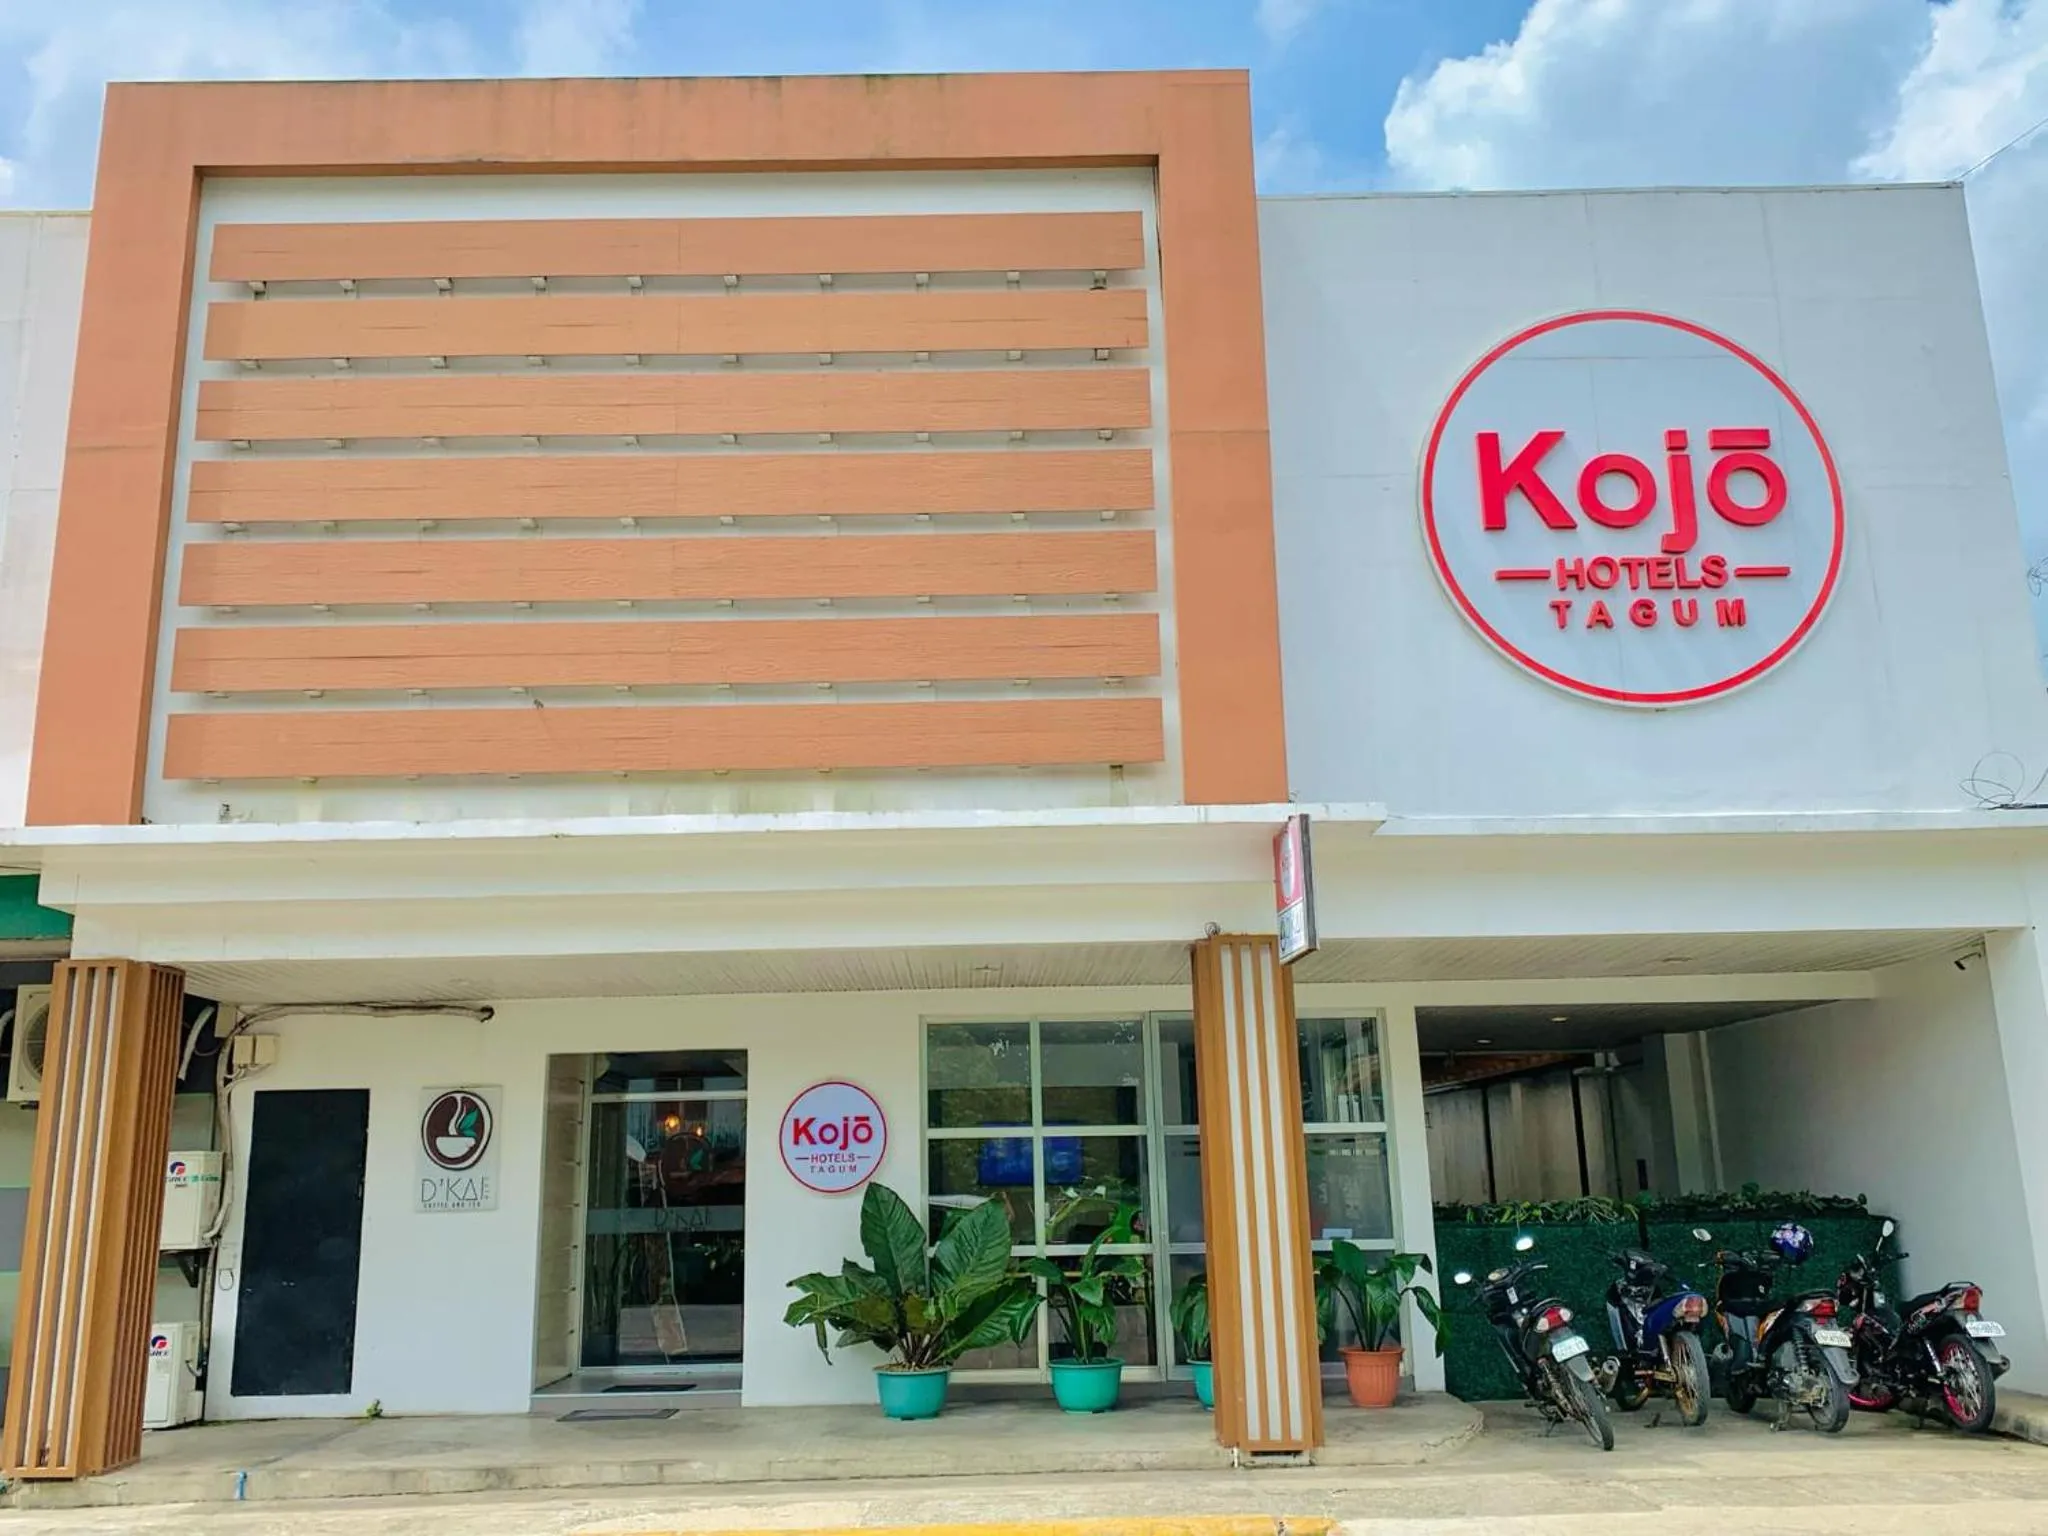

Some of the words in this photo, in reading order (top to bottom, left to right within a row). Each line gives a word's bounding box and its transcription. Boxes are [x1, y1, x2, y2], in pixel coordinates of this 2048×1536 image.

[1555, 555, 1730, 591] HOTELS
[1549, 598, 1748, 629] TAGUM
[810, 1153, 856, 1164] HOTELS
[809, 1165, 857, 1174] TAGUM
